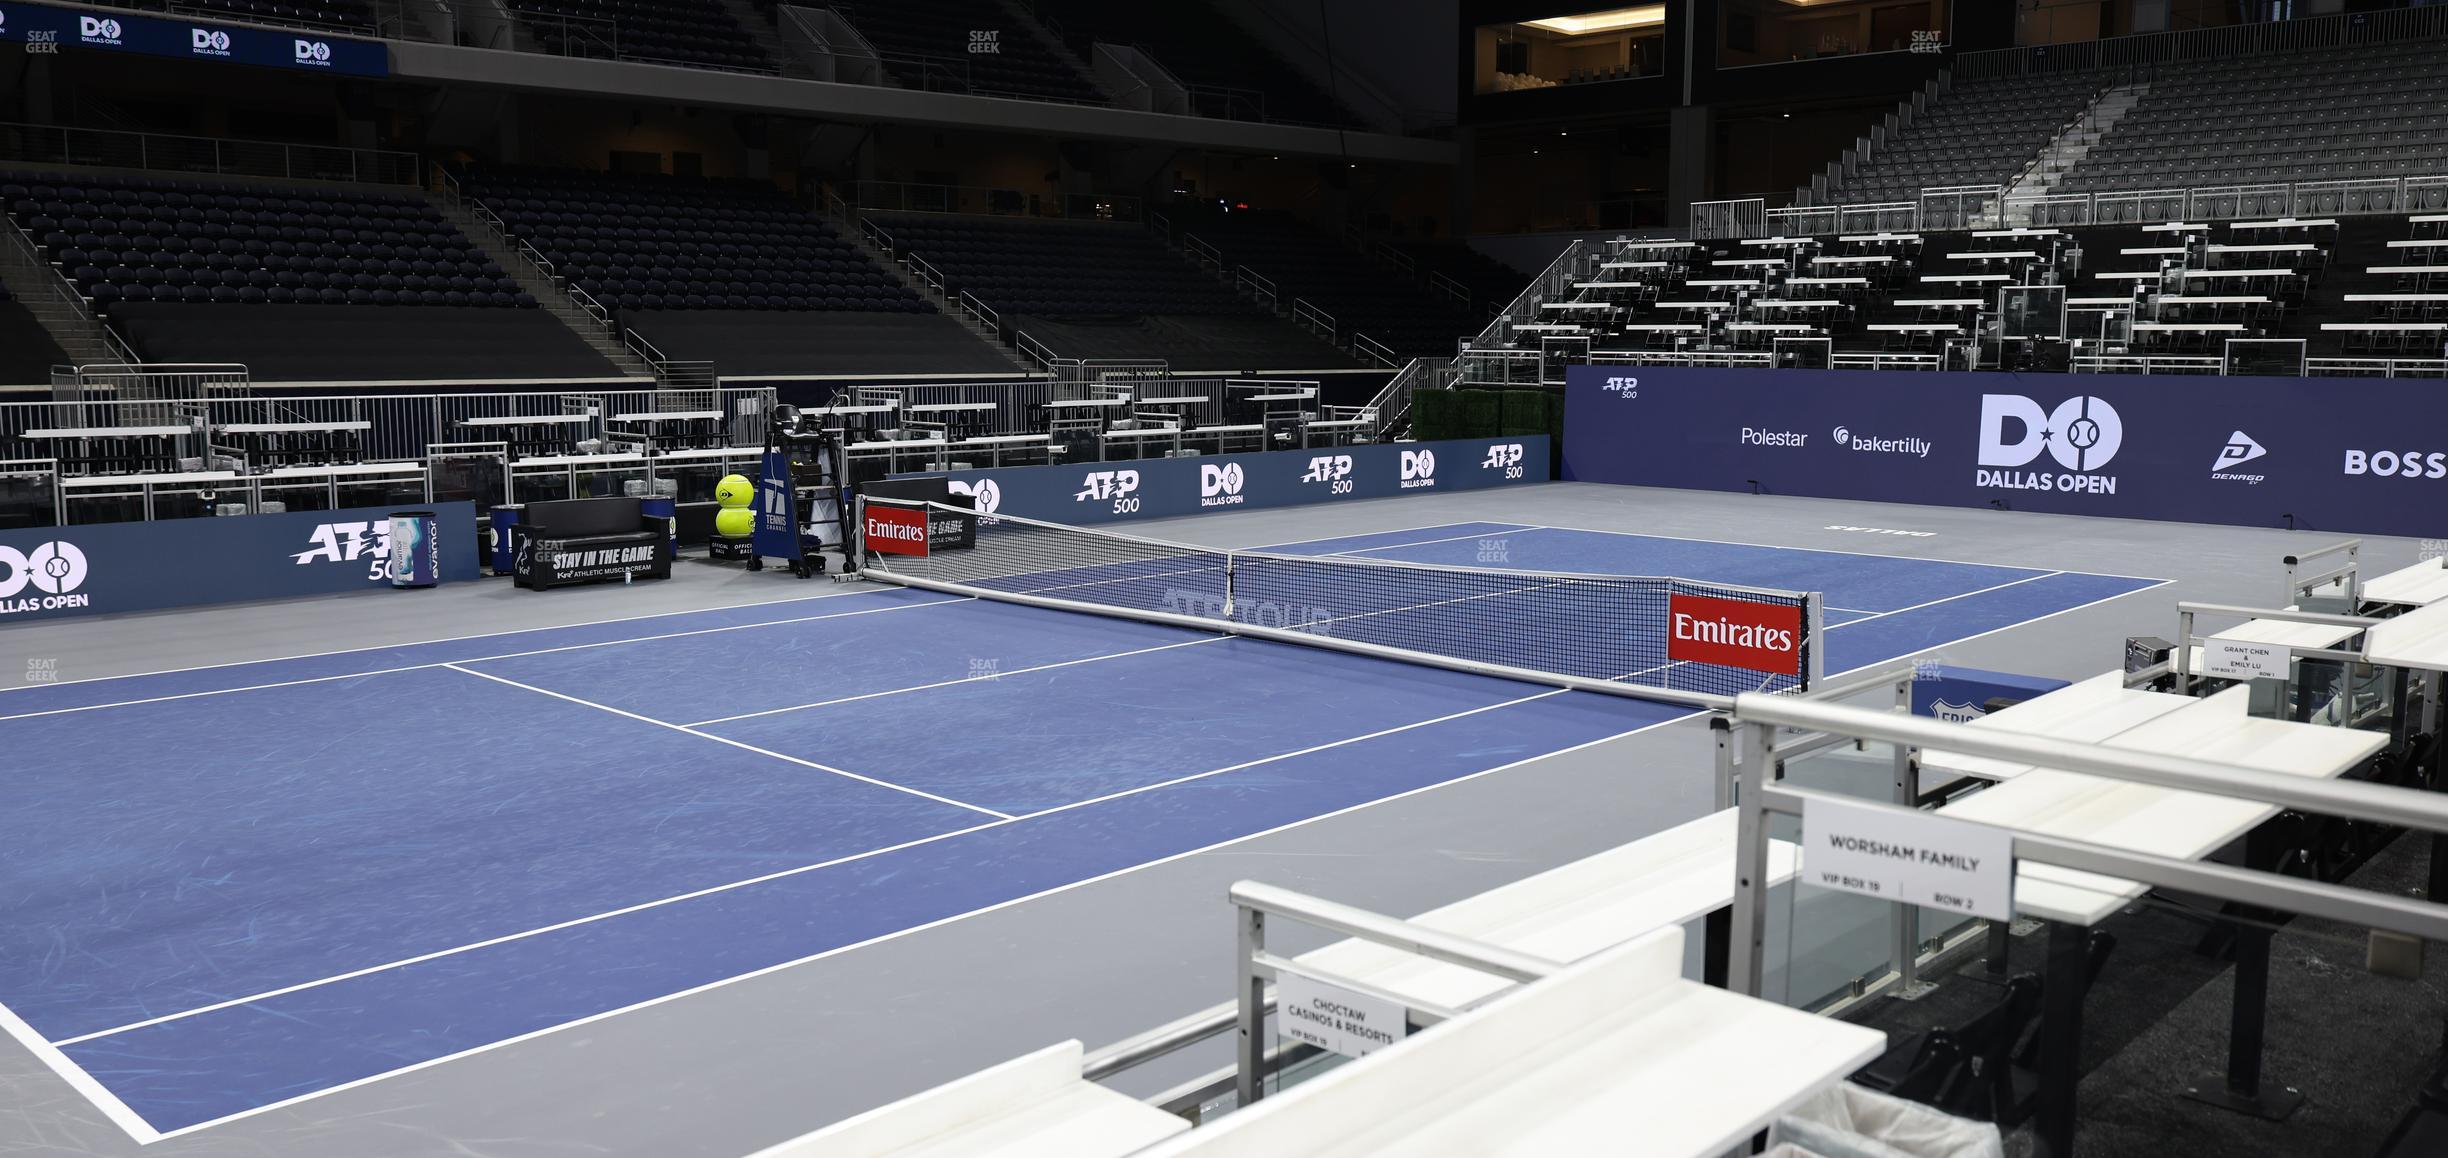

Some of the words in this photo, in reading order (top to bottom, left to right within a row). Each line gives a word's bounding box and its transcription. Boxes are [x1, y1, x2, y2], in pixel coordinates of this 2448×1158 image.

[1602, 377, 1637, 391] ATP
[1621, 390, 1637, 399] 500
[1741, 427, 1808, 447] Polestar
[1852, 435, 1931, 458] bakertilly
[1480, 443, 1523, 469] ATP
[2344, 449, 2447, 479] BOSS
[1300, 455, 1352, 483] ATP
[1505, 465, 1523, 480] 500
[2211, 473, 2265, 482] DENAGO
[1073, 469, 1140, 501] ATP
[1331, 480, 1352, 495] 500
[1401, 479, 1419, 488] DALLAS
[1420, 478, 1434, 487] OPEN
[1976, 469, 2052, 491] DALLAS
[2056, 474, 2116, 494] OPEN
[1113, 497, 1140, 514] 500
[1201, 496, 1225, 506] DALLAS
[1226, 495, 1243, 504] OPEN
[766, 514, 787, 526] TENNIS
[868, 518, 924, 542] Emirates
[430, 520, 439, 579] evamor
[553, 552, 582, 570] STAY
[583, 550, 597, 567] IN
[599, 549, 620, 565] THE
[621, 545, 655, 563] GAME
[574, 569, 603, 578] ATHLETIC
[0, 597, 40, 614] LLAS
[43, 593, 89, 610] OPEN
[1675, 612, 1792, 652] Emirates
[2224, 646, 2248, 654] GRANT
[2250, 648, 2270, 656] CHEN
[1829, 834, 1915, 860] WORSHAM
[1920, 849, 1981, 873] FAMILY
[1822, 872, 1840, 884] VIP
[1843, 876, 1866, 889] BOX
[1934, 892, 1964, 907] ROW
[1313, 997, 1366, 1022] CHOCTAW
[1288, 1004, 1333, 1028] CASINOS
[1336, 1020, 1342, 1030] &
[1345, 1022, 1394, 1045] RESORTS
[1290, 1028, 1302, 1037] VIP
[1303, 1032, 1318, 1041] BOX
